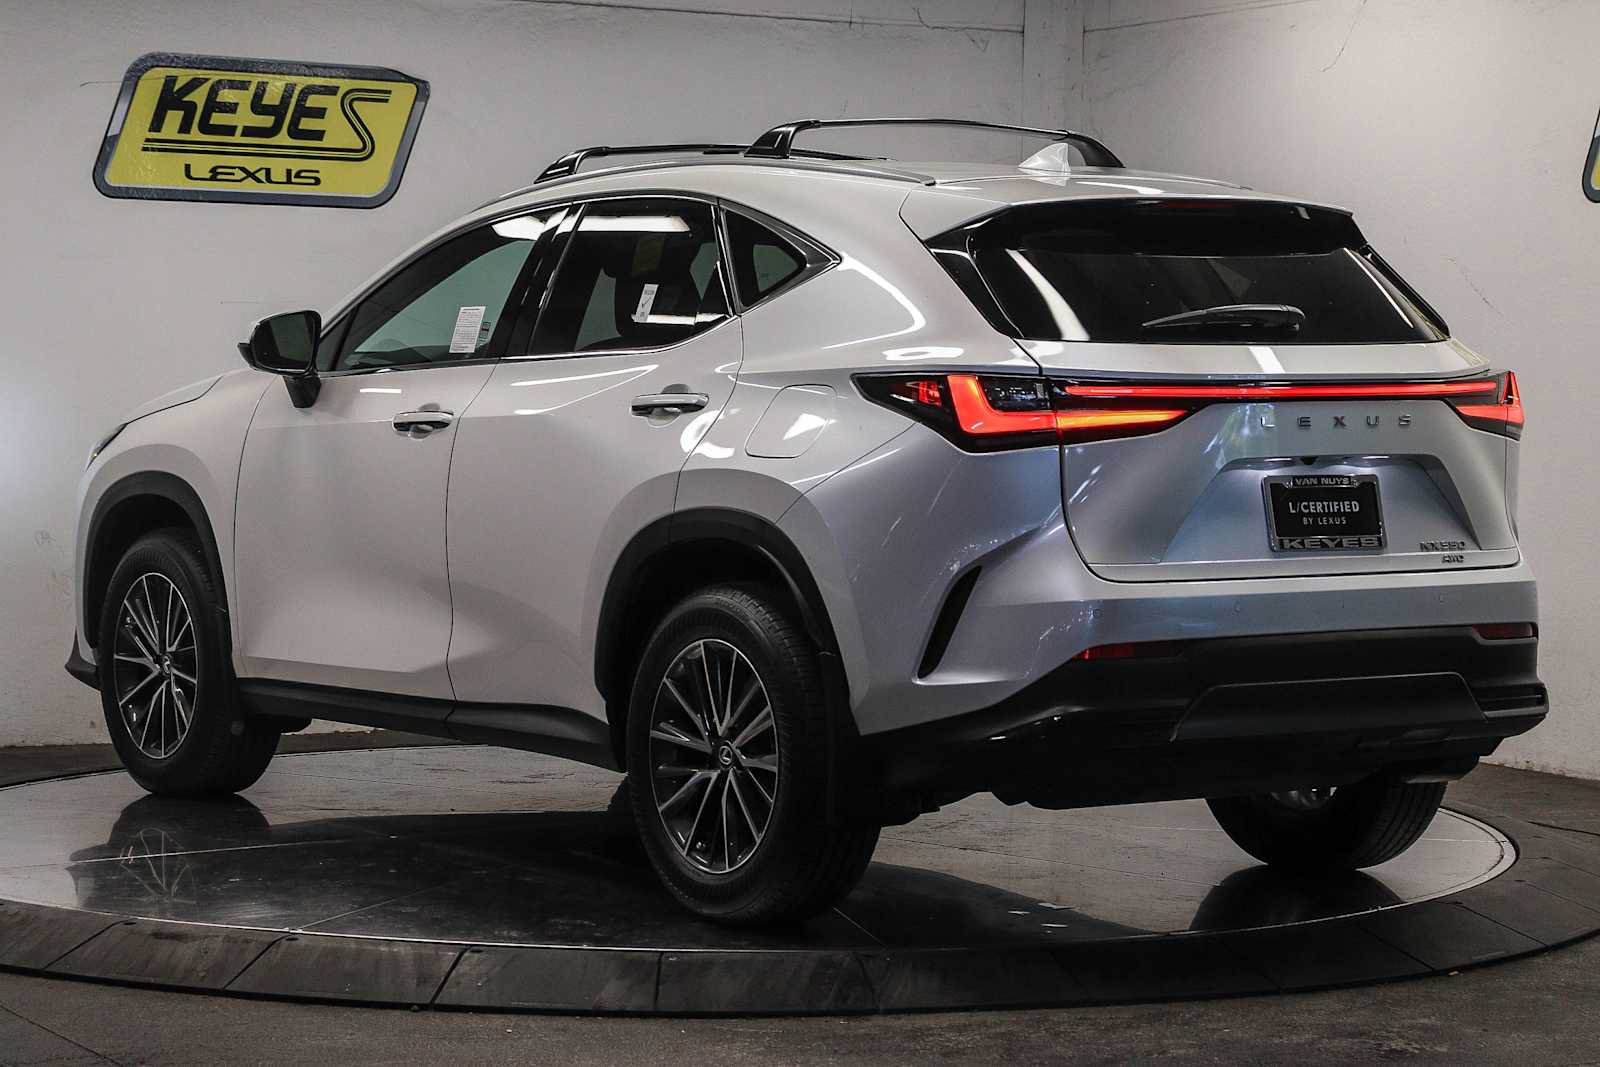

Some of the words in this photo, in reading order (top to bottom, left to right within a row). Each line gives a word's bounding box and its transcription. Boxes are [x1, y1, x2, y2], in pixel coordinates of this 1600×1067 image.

[142, 75, 392, 162] KEYES
[184, 163, 322, 186] LEXUS
[1260, 415, 1412, 428] LEXUS
[1295, 477, 1318, 486] VAN
[1321, 477, 1350, 486] NUYS
[1288, 501, 1360, 513] L/CERTIFIED
[1303, 517, 1313, 525] BY
[1318, 517, 1347, 525] LEXUS
[1281, 537, 1379, 549] KEYES
